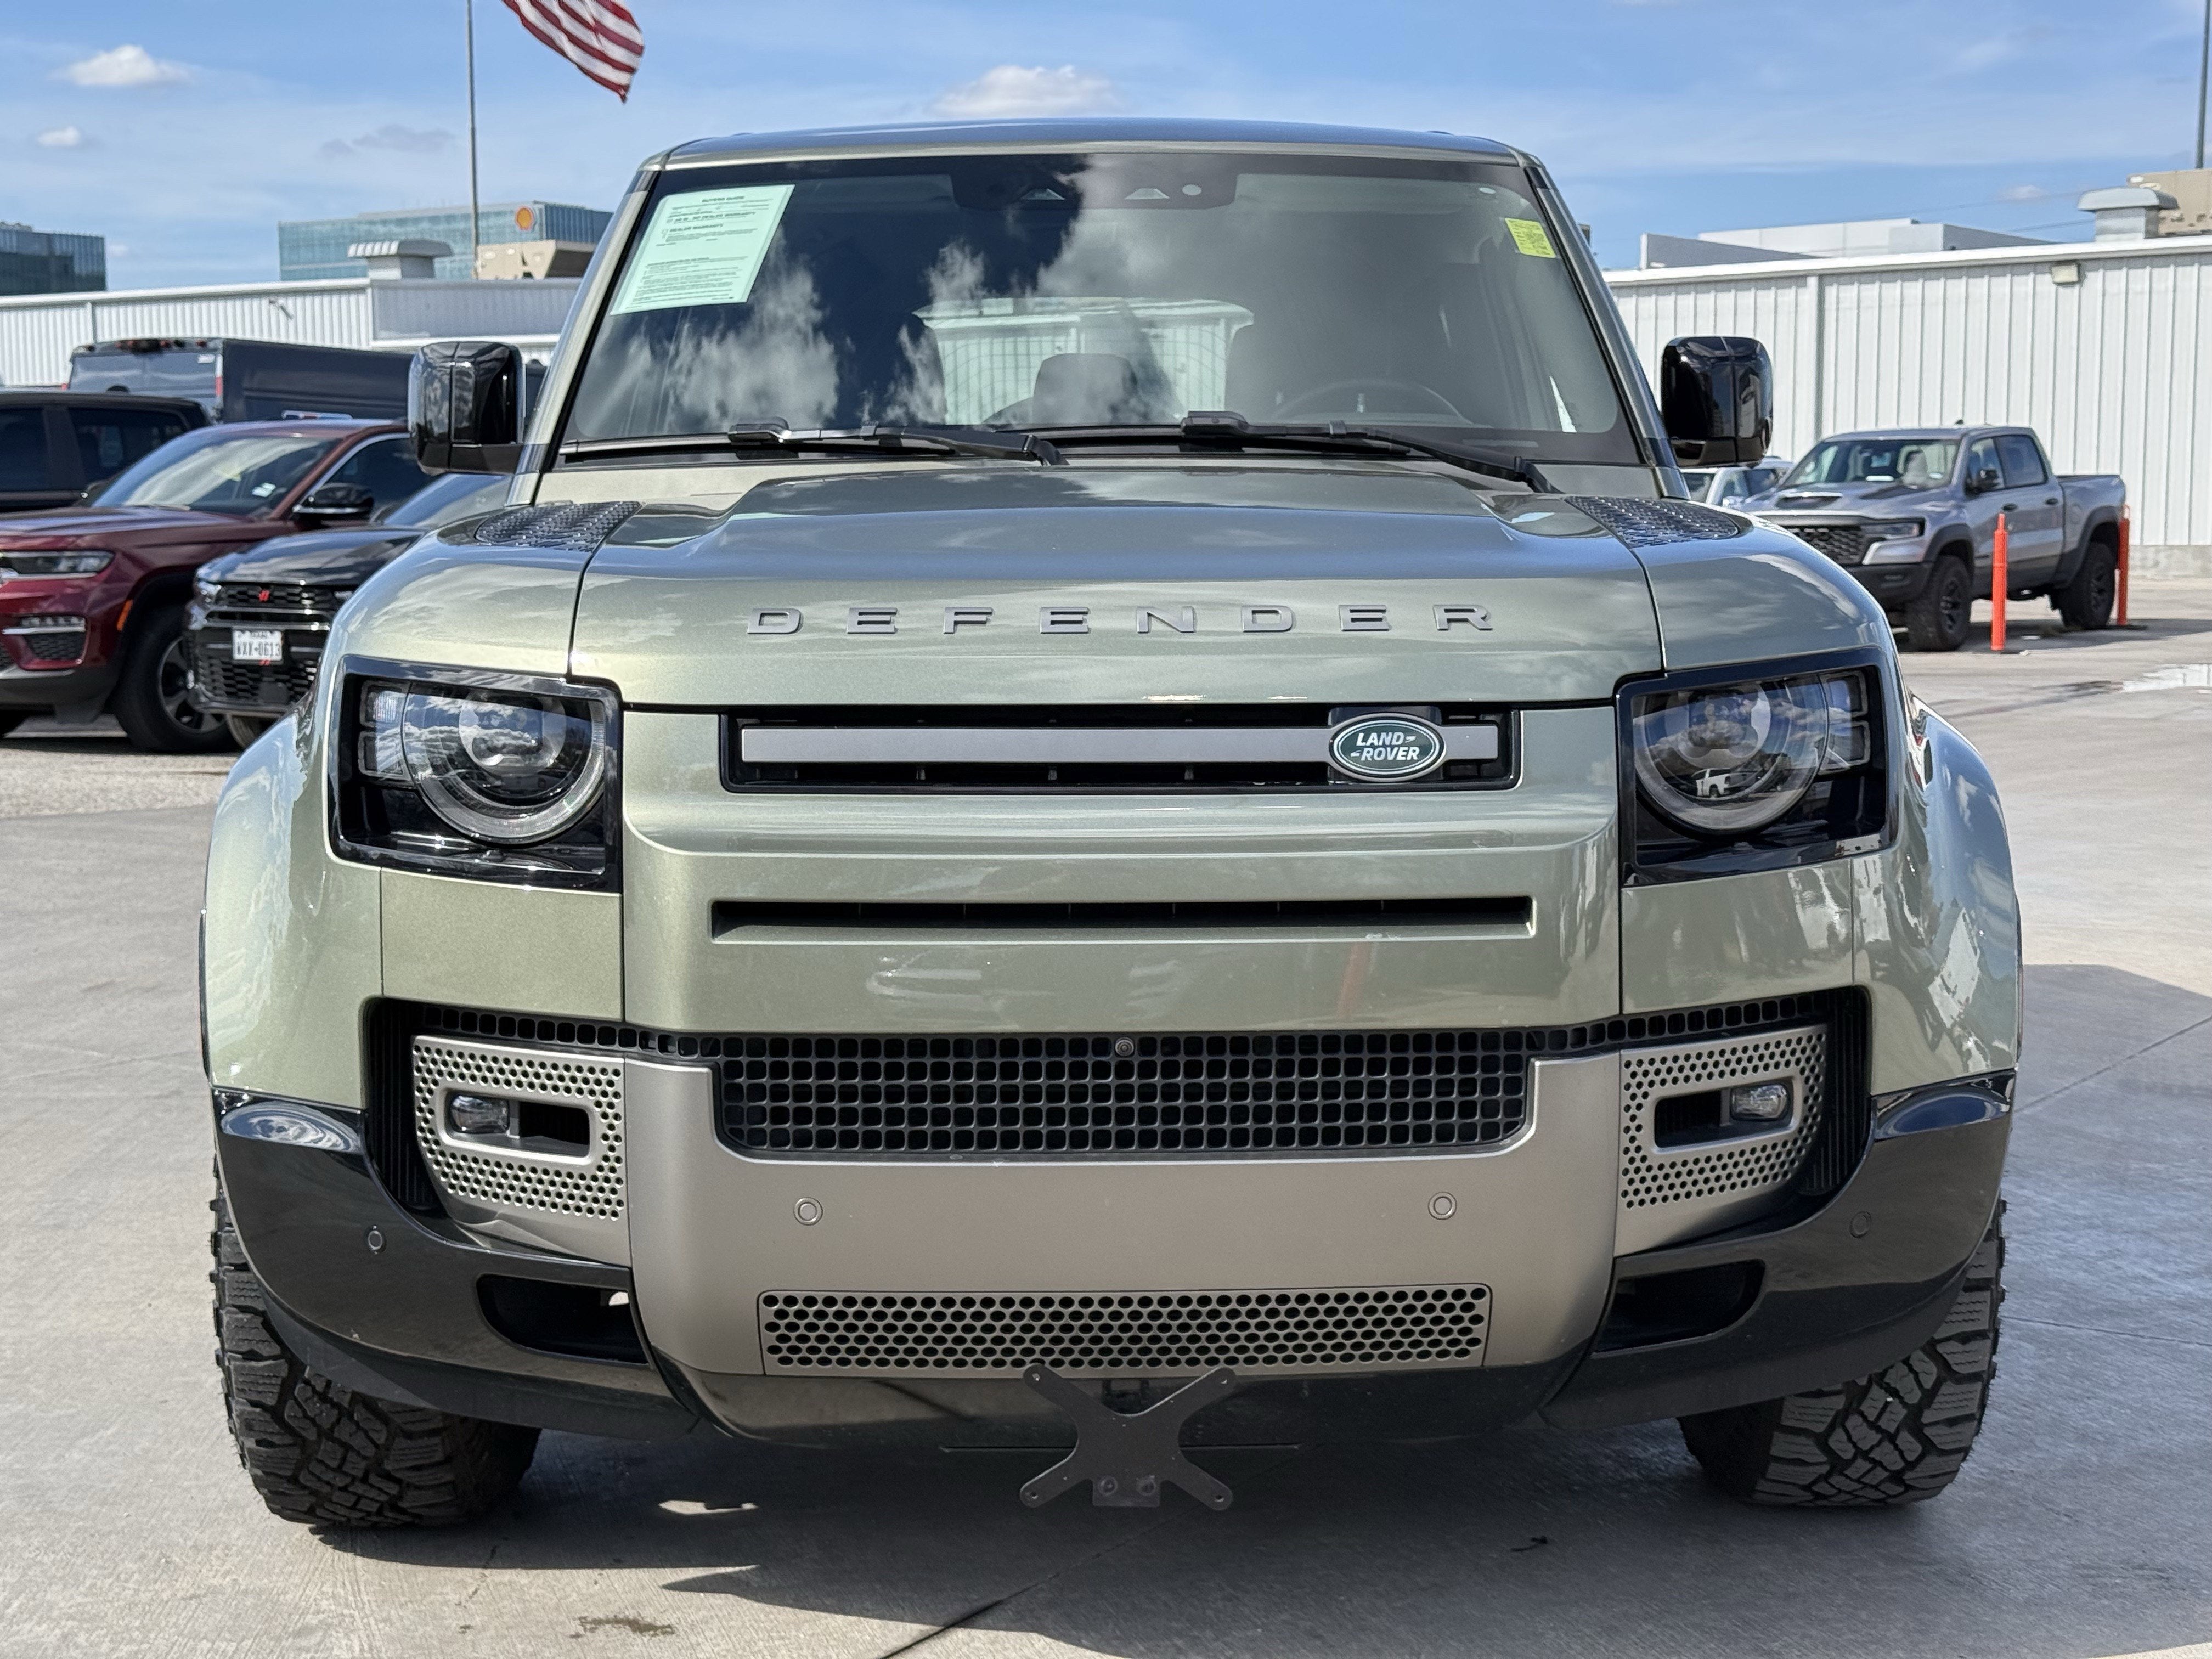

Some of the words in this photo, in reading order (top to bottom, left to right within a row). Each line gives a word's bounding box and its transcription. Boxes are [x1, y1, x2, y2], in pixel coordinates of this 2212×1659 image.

[747, 604, 1493, 635] DEFENDER
[1356, 732, 1404, 746] LAND
[1361, 747, 1420, 761] ROVER
